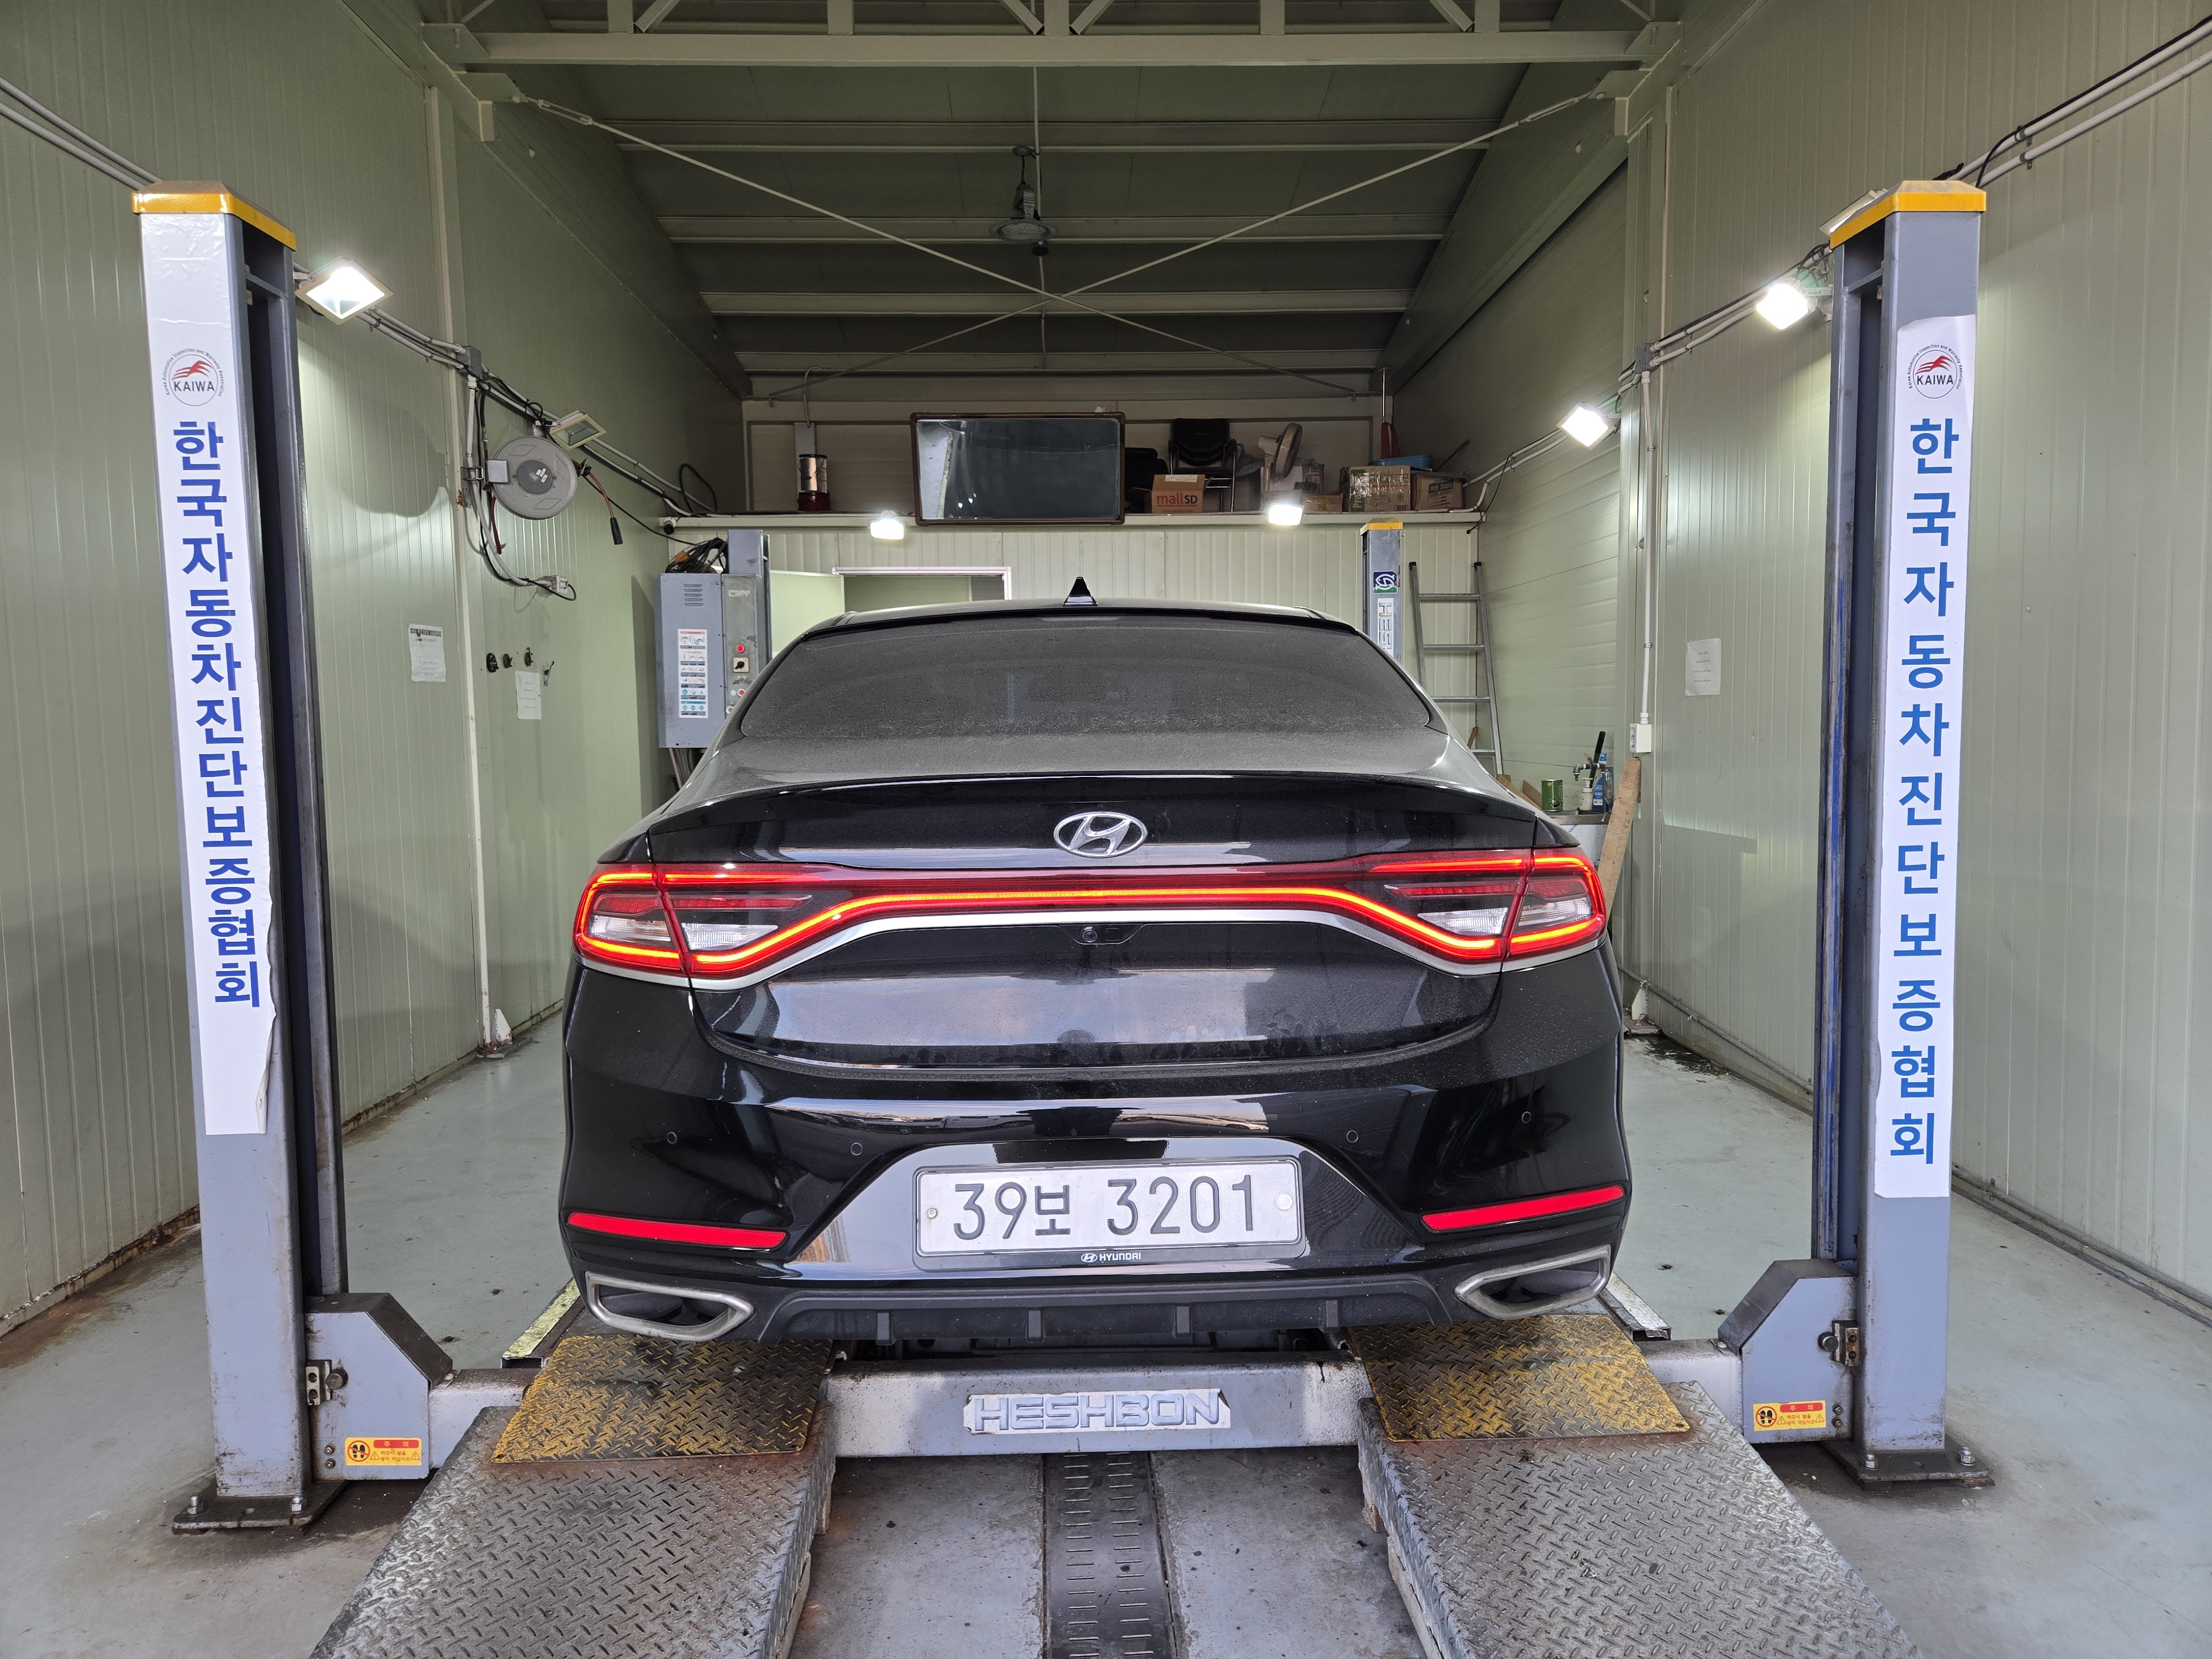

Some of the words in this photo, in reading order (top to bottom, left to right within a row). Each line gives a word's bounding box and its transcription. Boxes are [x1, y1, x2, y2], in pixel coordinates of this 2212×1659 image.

[1918, 344, 1939, 353] Inspection
[1948, 347, 1961, 363] Warranty
[174, 381, 215, 392] KAIWA
[1917, 375, 1954, 385] KAIWA
[173, 421, 260, 1008] 한국자동차진단보증협회
[1890, 418, 1959, 1165] 한국자동차진단보증협회
[953, 1181, 1071, 1240] 39보
[1107, 1174, 1254, 1235] 3201
[1099, 1252, 1141, 1261] HYUNDAI
[974, 1392, 1220, 1431] HESHBON
